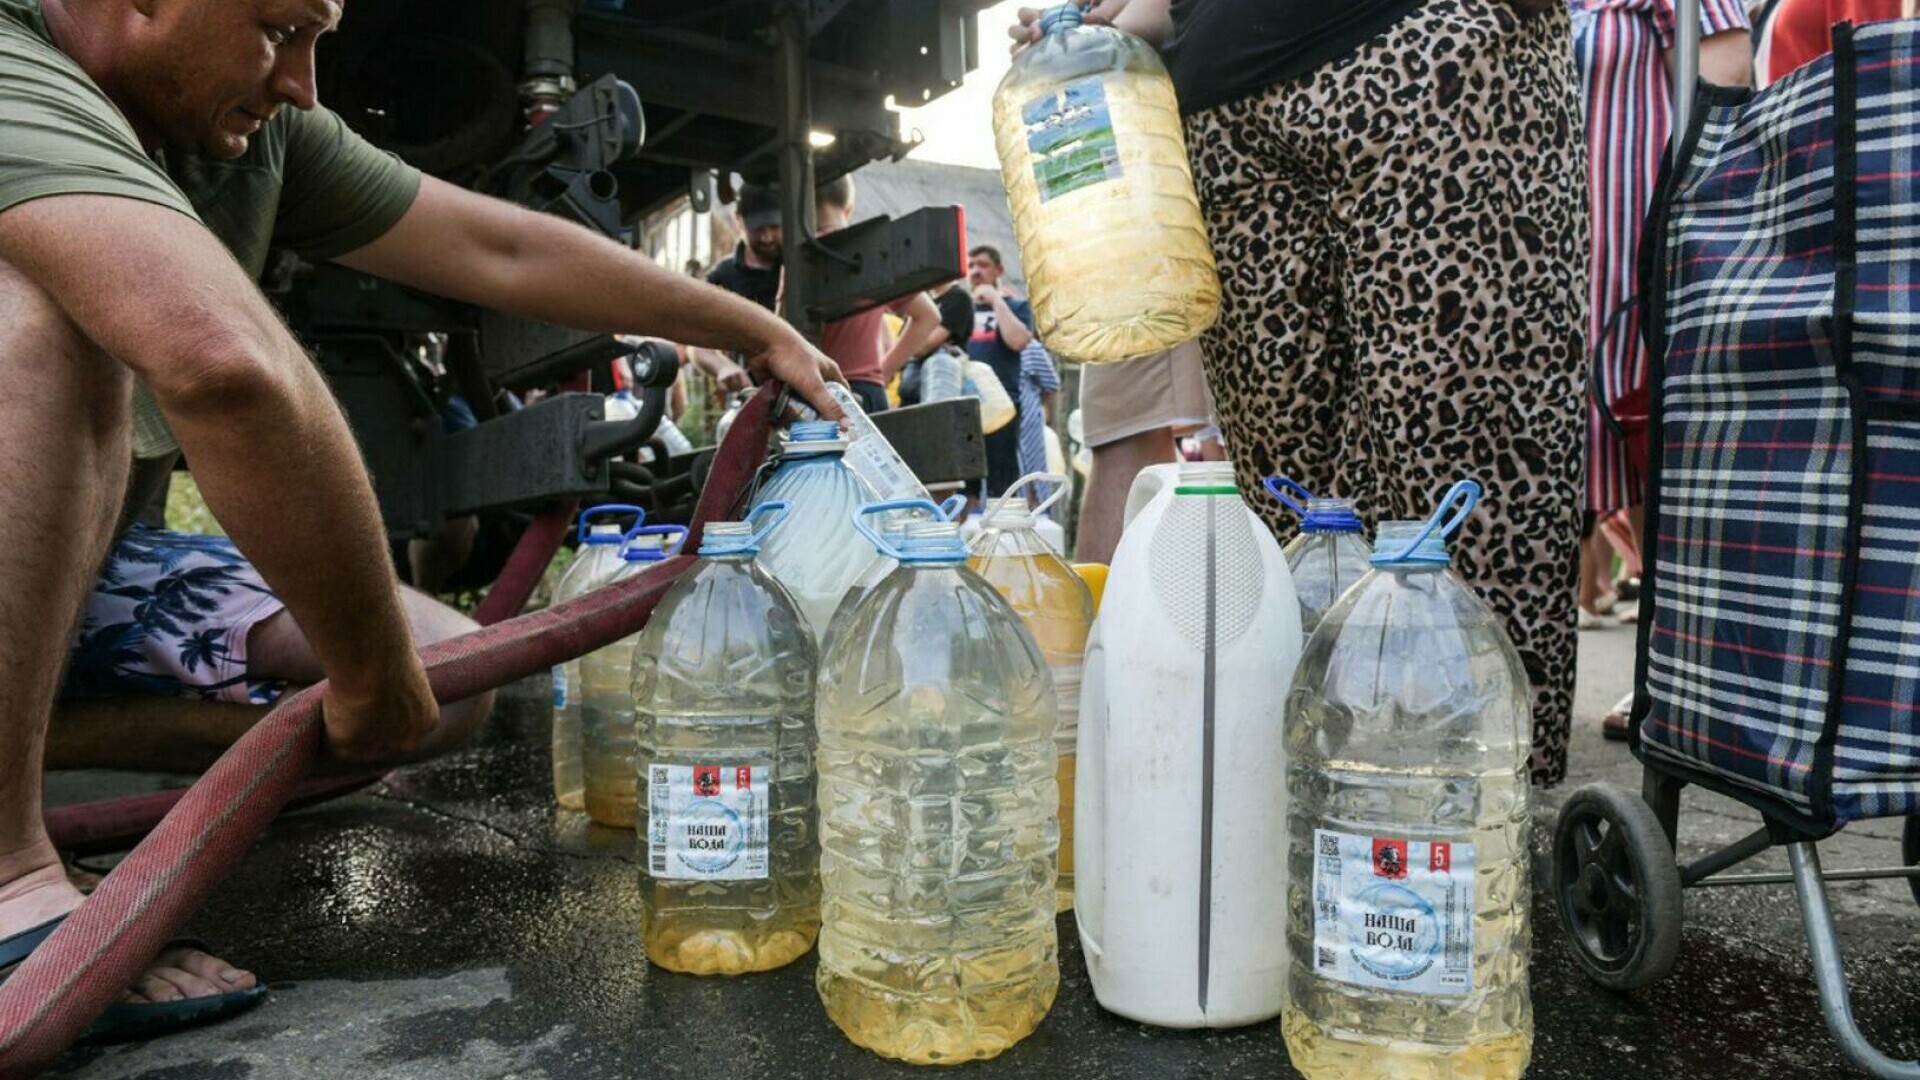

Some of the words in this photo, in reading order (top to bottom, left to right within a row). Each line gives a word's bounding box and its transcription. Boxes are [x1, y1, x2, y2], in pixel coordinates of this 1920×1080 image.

[687, 825, 726, 836] НАША
[1435, 846, 1444, 867] 5
[1364, 913, 1415, 933] НАША
[1366, 932, 1414, 951] ВОДА
